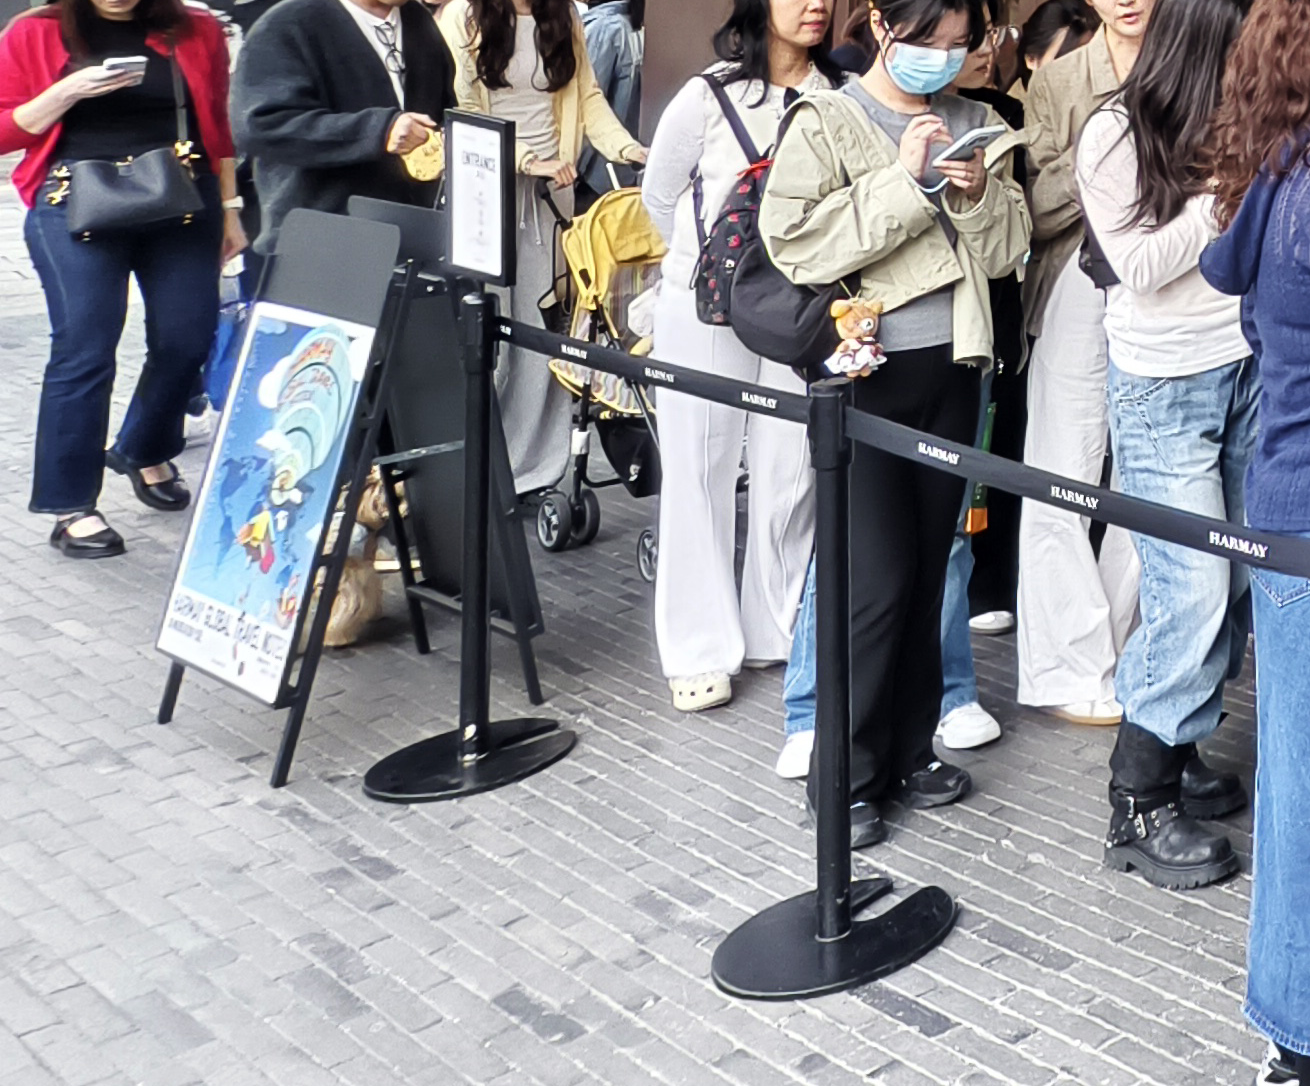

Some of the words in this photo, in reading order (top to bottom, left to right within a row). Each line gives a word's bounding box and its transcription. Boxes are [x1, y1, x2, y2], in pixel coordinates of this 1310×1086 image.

[645, 367, 675, 383] HARMAY
[741, 392, 778, 409] HARMAY
[918, 441, 960, 465] HARMAY
[1051, 485, 1099, 509] HARMAY
[1209, 531, 1268, 558] HARMAY
